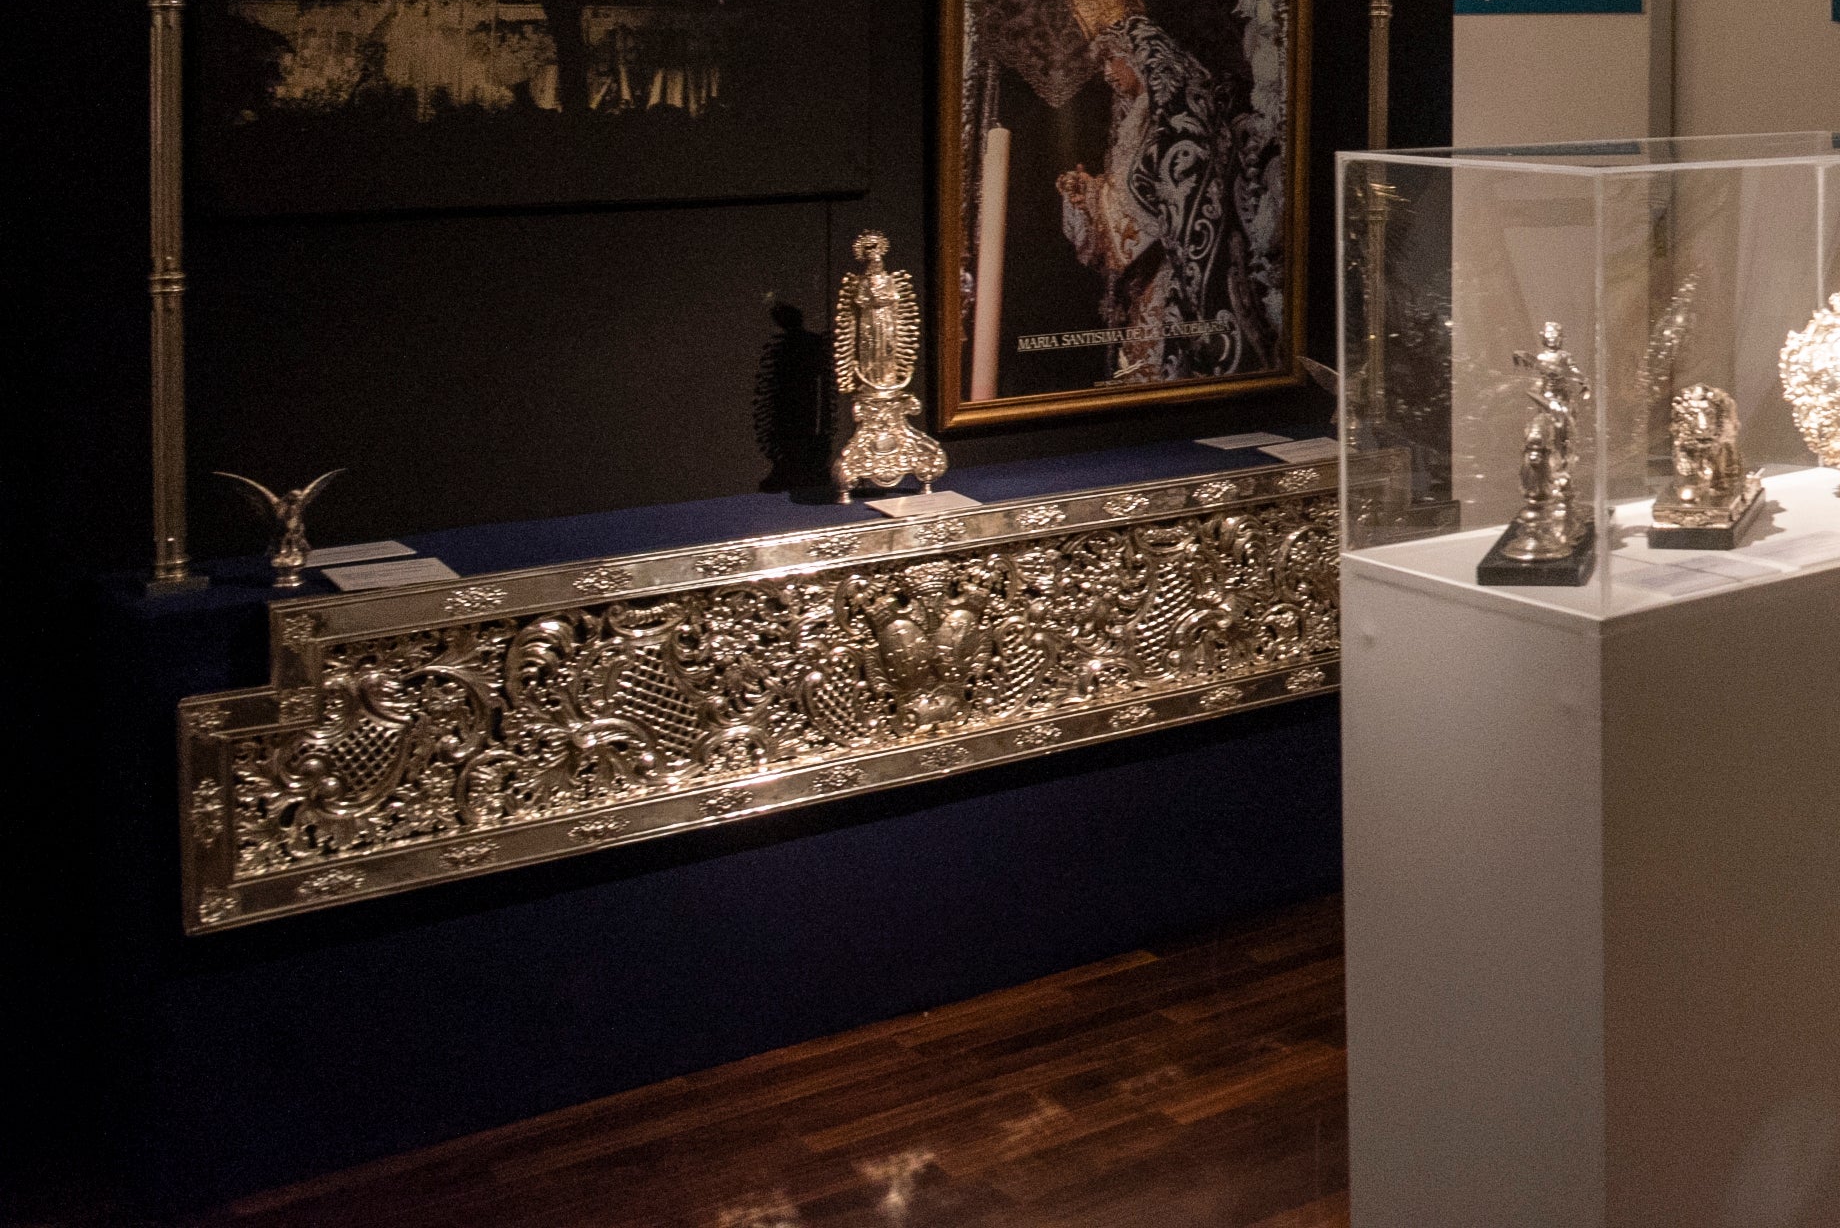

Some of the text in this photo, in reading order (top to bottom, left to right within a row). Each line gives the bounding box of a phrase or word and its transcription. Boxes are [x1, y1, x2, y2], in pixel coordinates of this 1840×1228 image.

[1018, 335, 1059, 350] MARIA
[1062, 330, 1124, 347] SANTISIMA
[1125, 328, 1143, 342] DE
